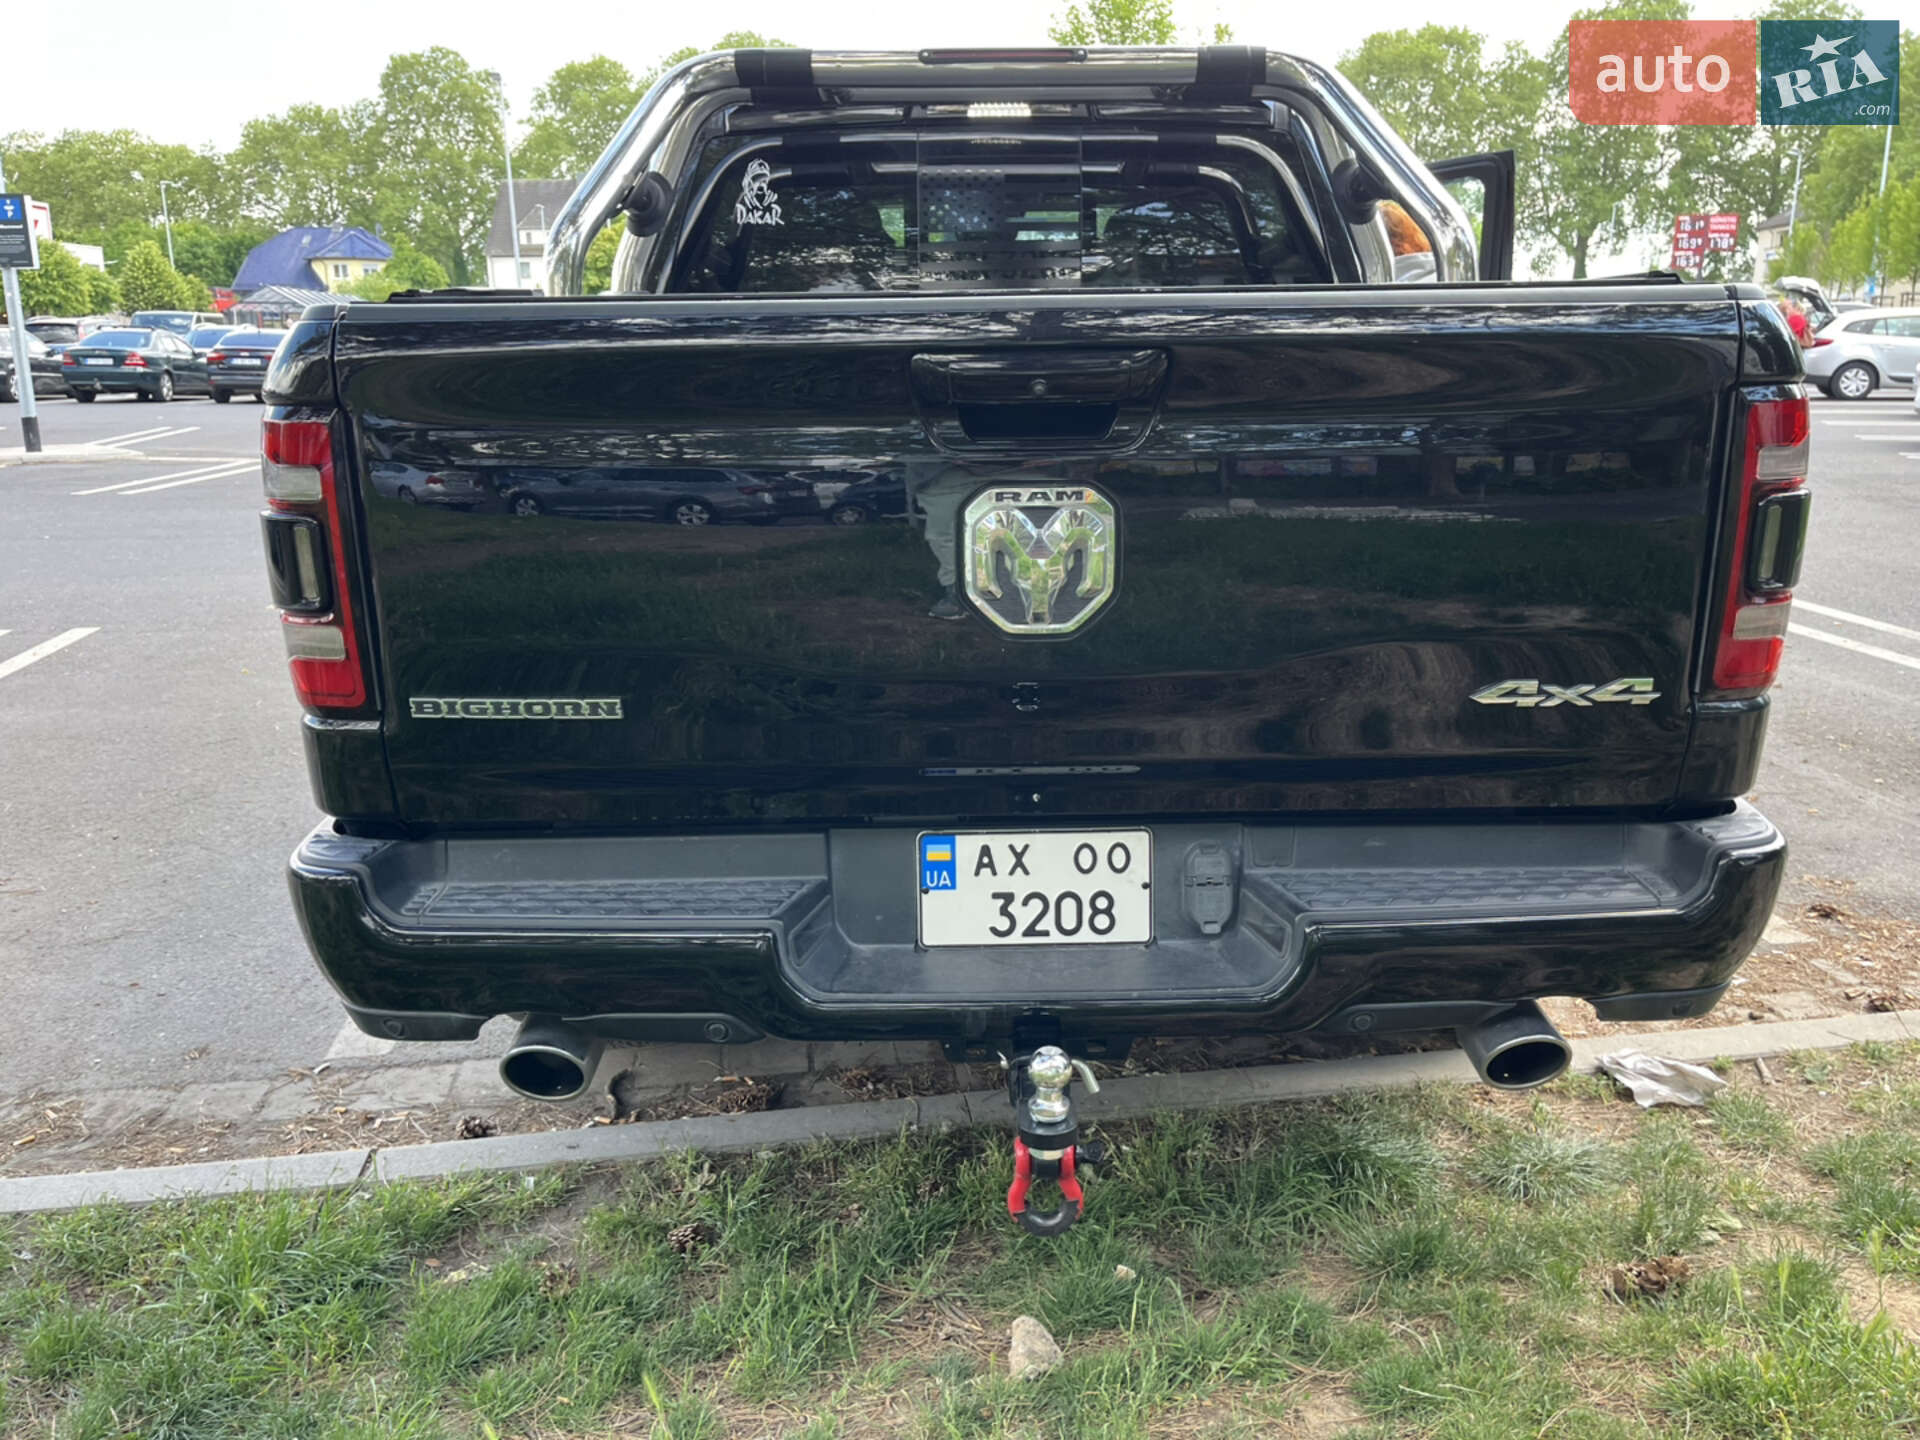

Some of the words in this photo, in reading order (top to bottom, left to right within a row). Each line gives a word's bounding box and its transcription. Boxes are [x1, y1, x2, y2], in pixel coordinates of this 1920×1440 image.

[736, 203, 785, 226] DAKAR
[995, 490, 1084, 503] RAM
[1468, 677, 1662, 708] 4x4
[409, 697, 624, 719] BIGHORN
[974, 843, 1031, 877] AX
[926, 870, 952, 887] UA
[989, 890, 1116, 938] 3208
